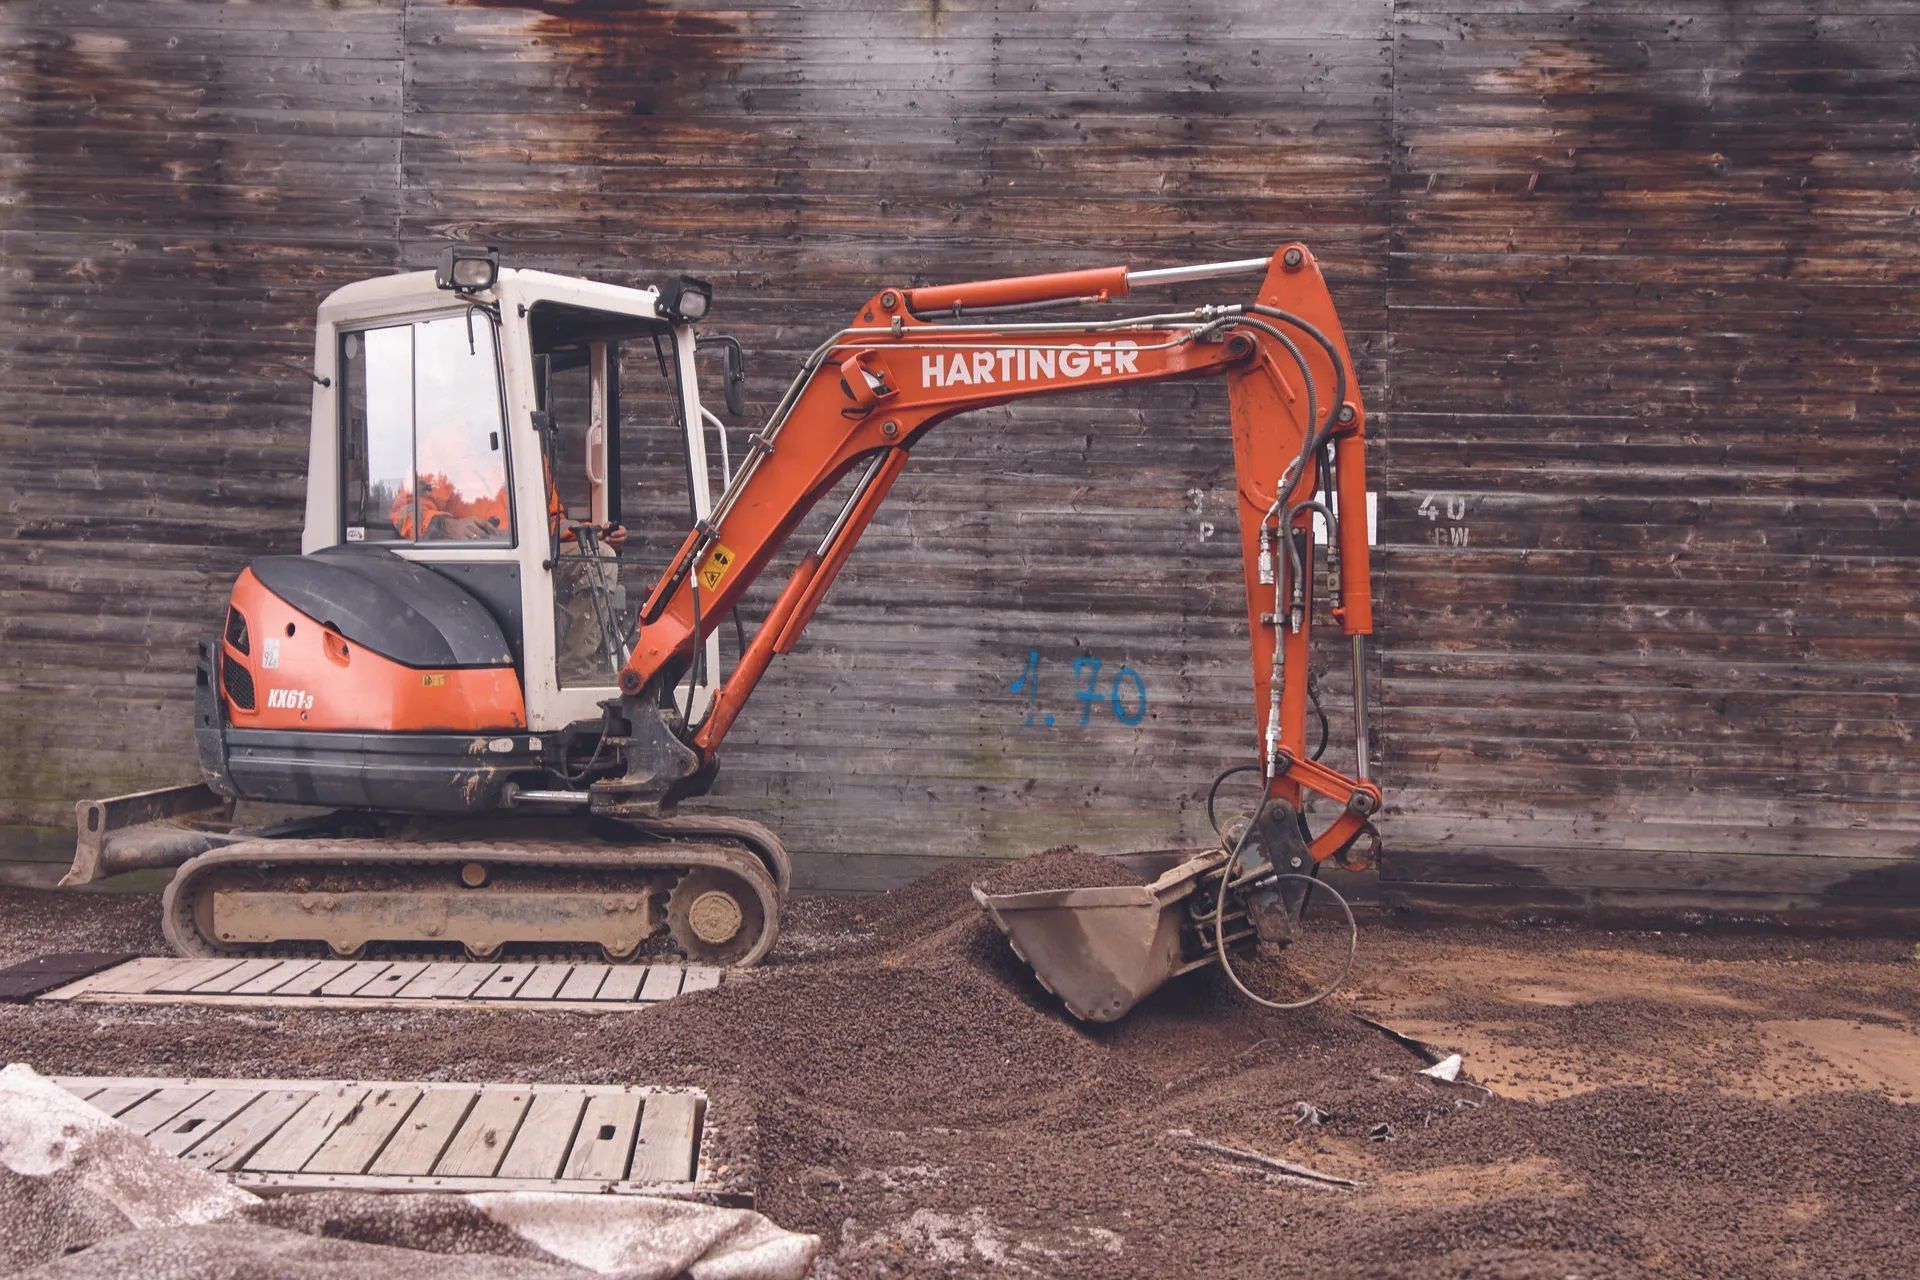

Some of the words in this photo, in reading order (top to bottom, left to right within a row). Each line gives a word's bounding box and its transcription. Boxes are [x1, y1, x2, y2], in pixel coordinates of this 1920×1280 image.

[922, 340, 1139, 388] HARTINGER
[1199, 521, 1215, 543] P
[1009, 648, 1147, 728] 1.70
